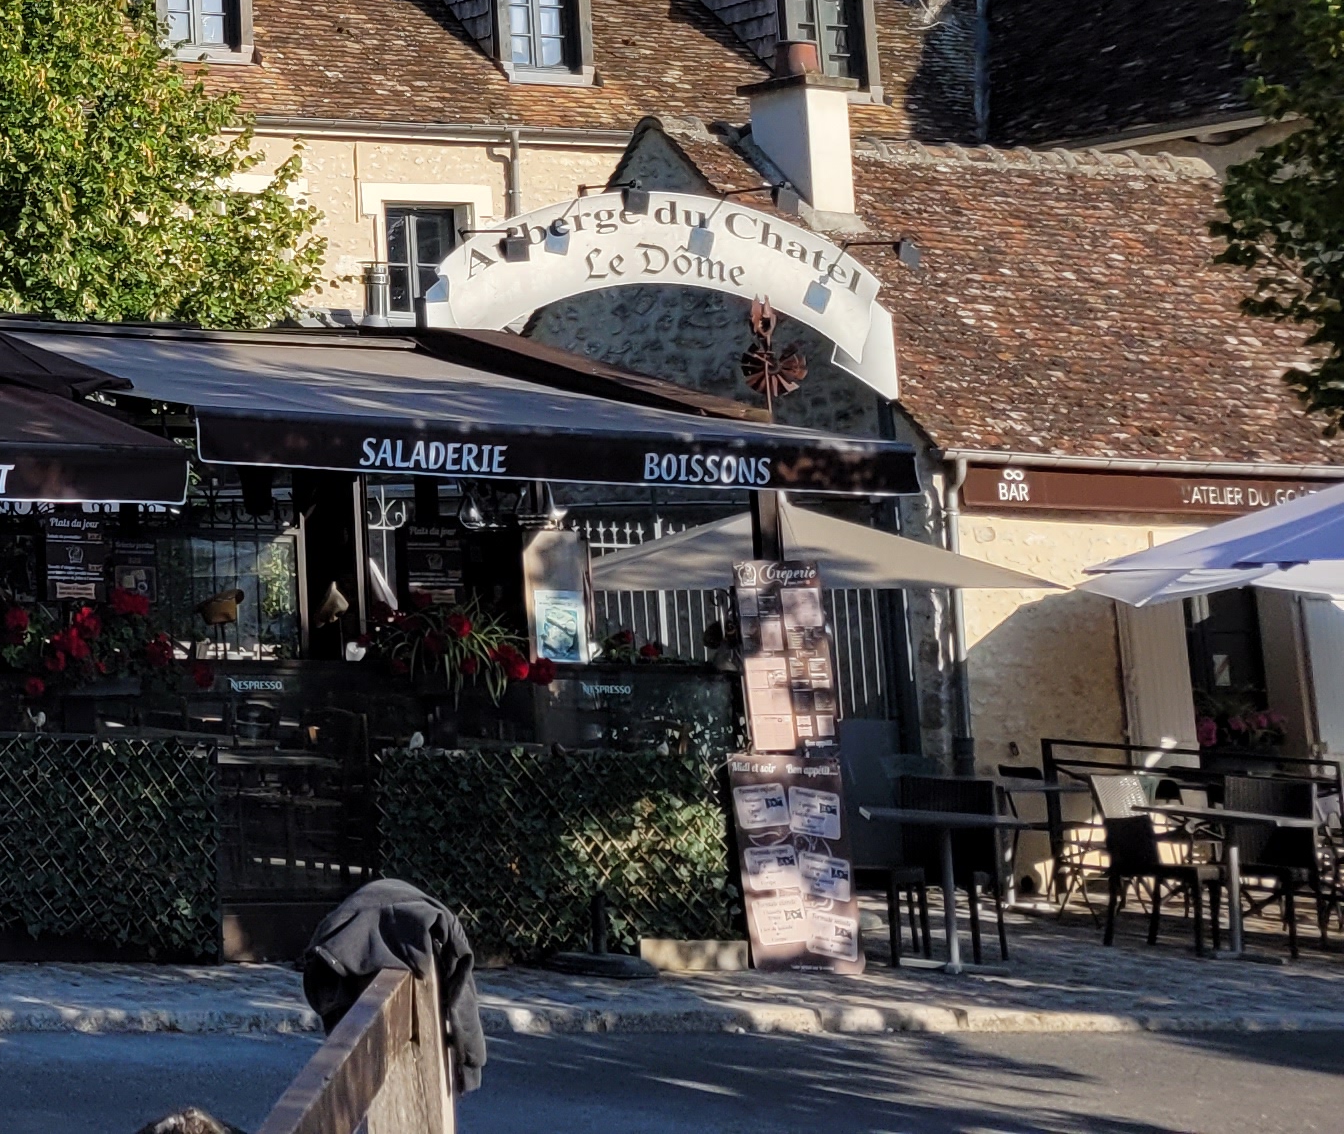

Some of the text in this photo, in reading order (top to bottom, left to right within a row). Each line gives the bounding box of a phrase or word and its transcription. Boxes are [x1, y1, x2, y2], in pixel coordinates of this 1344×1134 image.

[585, 242, 746, 287] Le Dôme
[654, 200, 708, 228] du
[725, 212, 862, 295] Chatel
[359, 437, 508, 474] SALADERIE
[643, 452, 772, 486] BOISSONS
[998, 483, 1030, 502] BAR
[1248, 488, 1270, 506] DU
[226, 677, 283, 693] NESPRESSO
